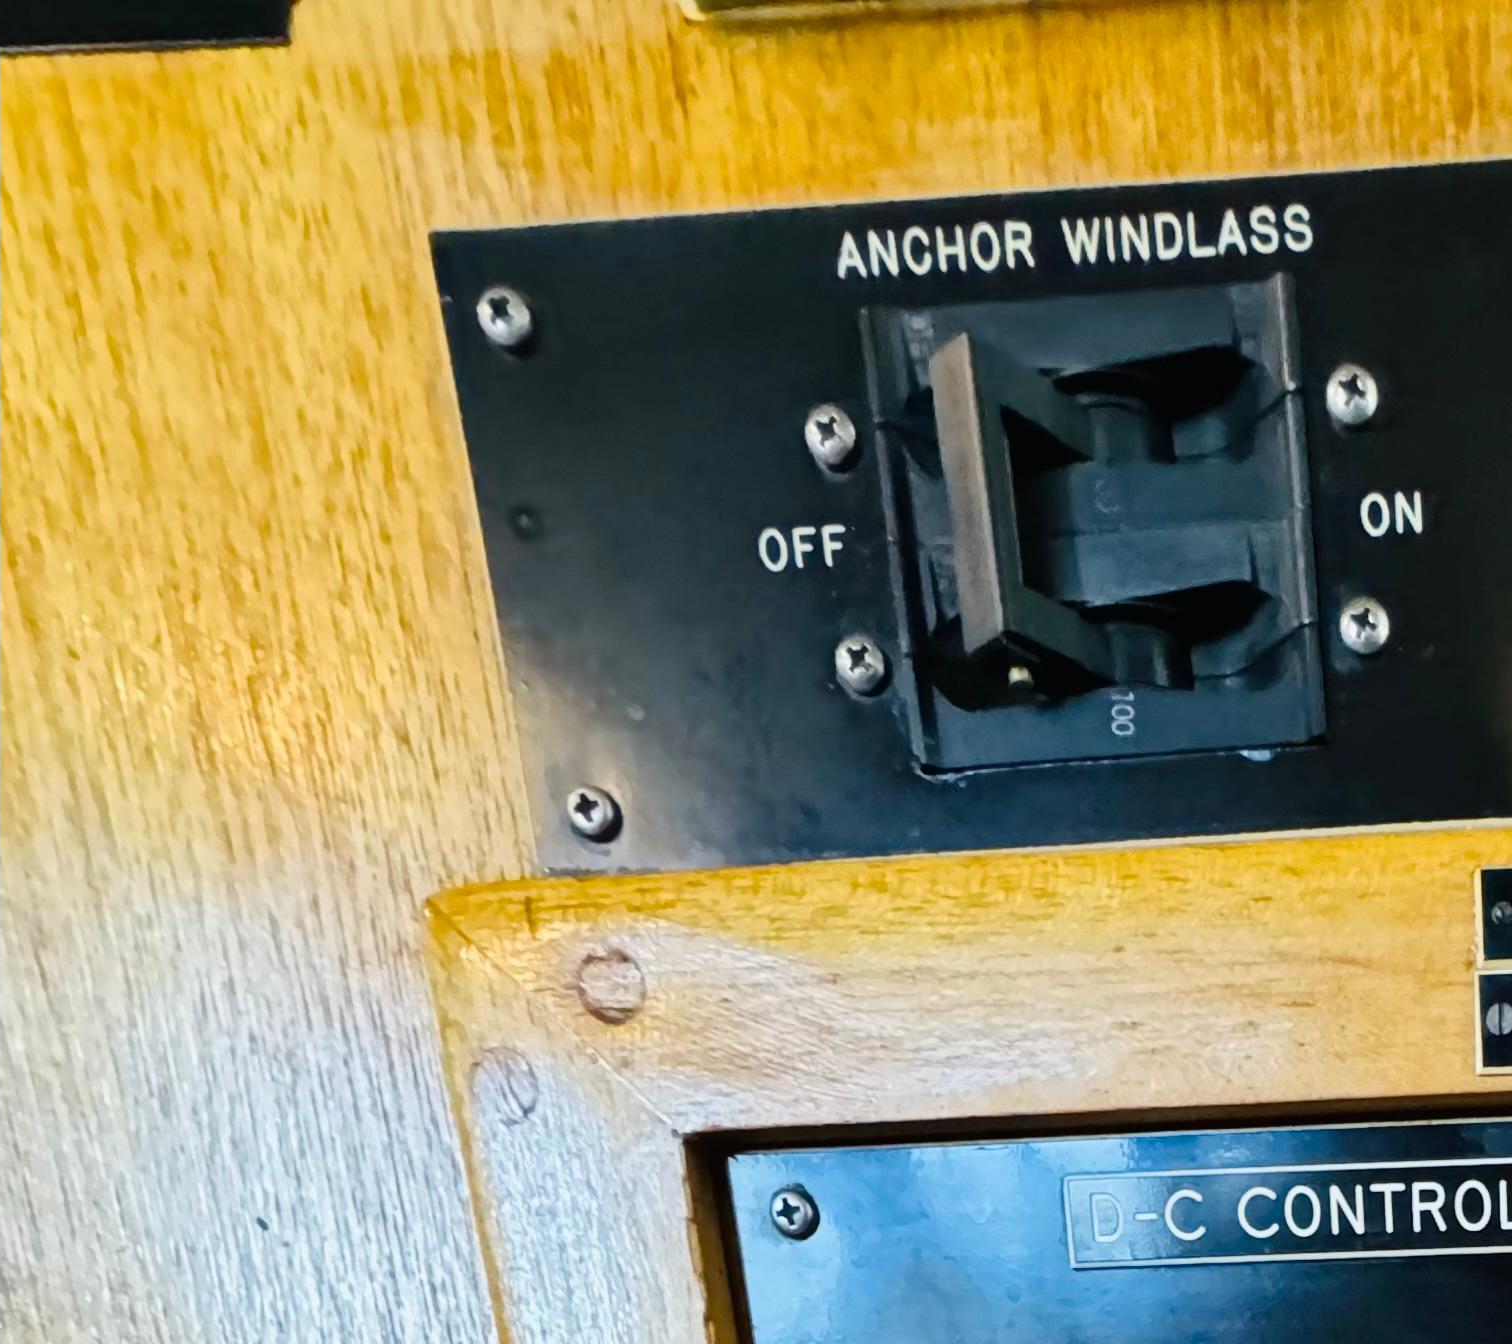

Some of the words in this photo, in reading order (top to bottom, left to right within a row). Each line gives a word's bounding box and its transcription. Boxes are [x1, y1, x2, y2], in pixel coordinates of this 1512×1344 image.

[836, 218, 1036, 282] ANCHOR
[1063, 204, 1318, 266] WINDLASS
[1359, 491, 1425, 538] ON
[756, 524, 848, 574] OFF
[1110, 690, 1137, 737] 100
[1089, 1188, 1207, 1246] D-C
